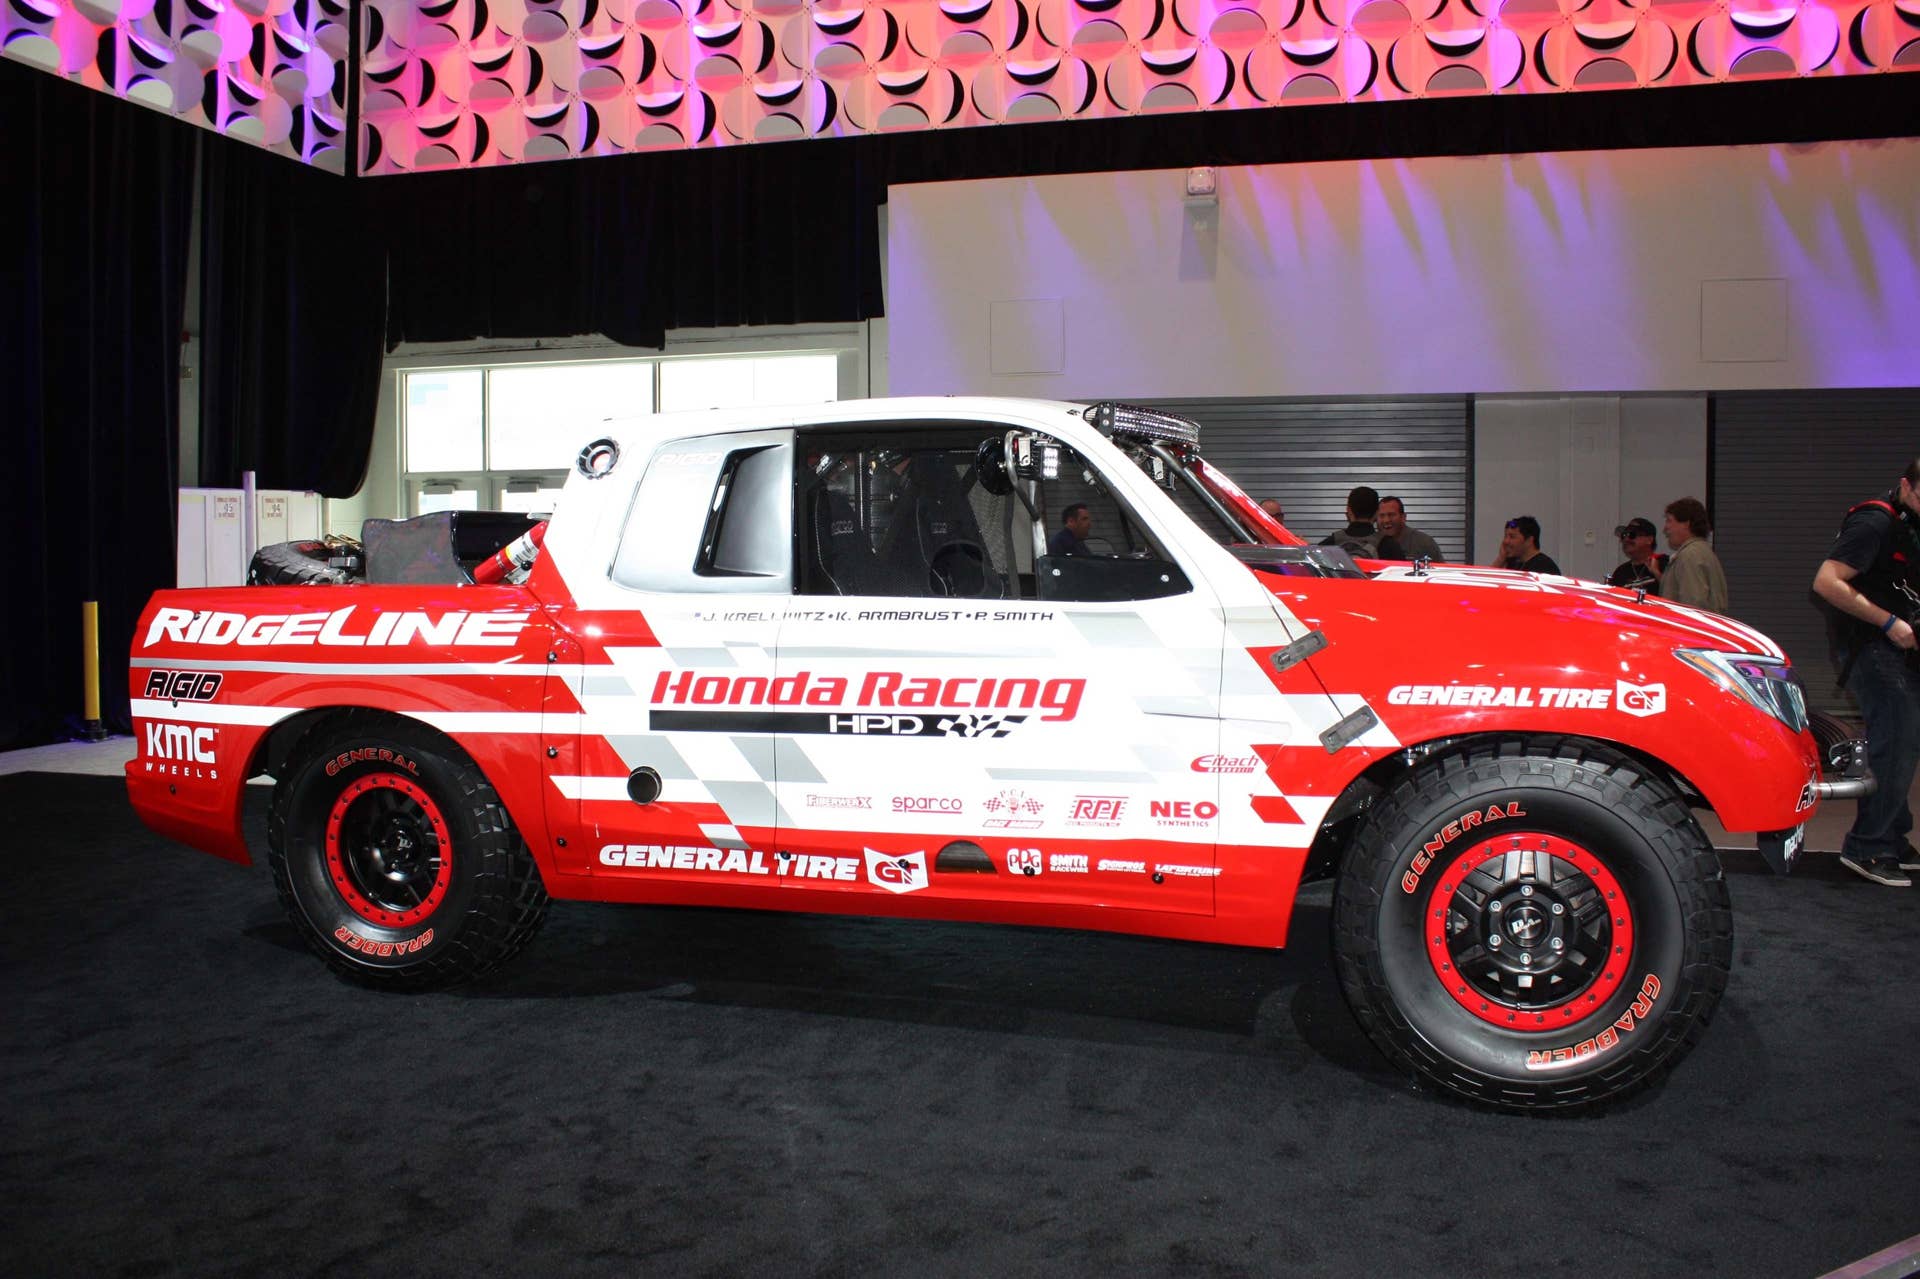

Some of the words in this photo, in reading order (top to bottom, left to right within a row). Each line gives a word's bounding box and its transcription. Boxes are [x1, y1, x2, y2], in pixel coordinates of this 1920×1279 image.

[143, 604, 530, 648] RIDGELINE
[993, 611, 1053, 621] SMITH
[144, 669, 224, 702] RIGID
[650, 671, 848, 706] Honda
[857, 671, 1087, 722] Racing
[1387, 685, 1533, 708] GENERAL
[1538, 688, 1613, 709] TIRE
[829, 714, 924, 734] HPD
[146, 722, 216, 764] KMC
[146, 762, 217, 780] WHEELS
[325, 747, 419, 777] GENERAL
[1190, 754, 1259, 773] Eibach
[892, 796, 963, 814] sparco
[1073, 799, 1122, 820] RPI
[1150, 800, 1219, 819] NEO
[1009, 849, 1041, 870] PPG
[1401, 801, 1526, 894] GENERAL
[600, 845, 768, 874] GENERAL
[774, 852, 860, 881] TIRE
[334, 925, 434, 957] GRABBER
[1527, 973, 1661, 1067] GRABBER
